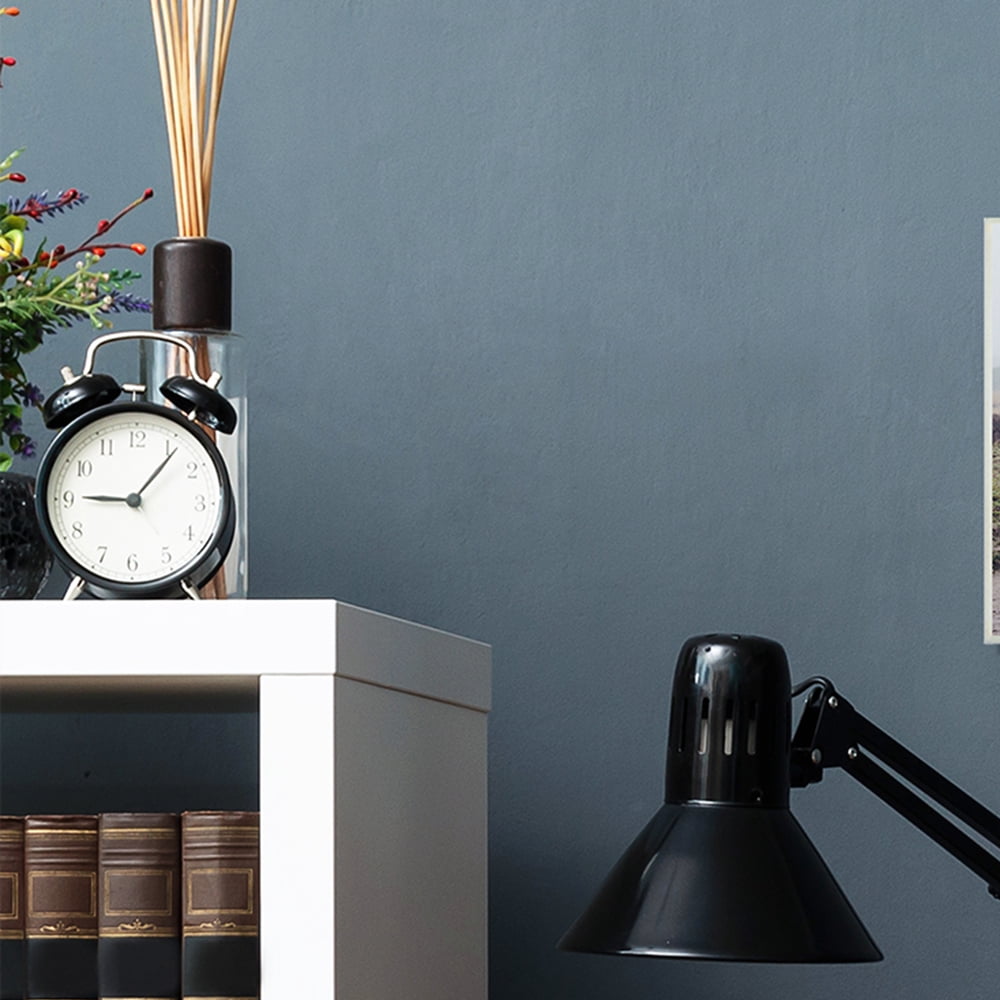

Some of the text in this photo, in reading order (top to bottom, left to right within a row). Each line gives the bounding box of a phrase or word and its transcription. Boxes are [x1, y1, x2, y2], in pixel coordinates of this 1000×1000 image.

[100, 439, 113, 456] 11
[129, 431, 146, 448] 12
[77, 460, 92, 477] 10
[186, 462, 198, 479] 2
[63, 491, 74, 508] 9
[195, 495, 206, 512] 3
[72, 521, 83, 538] 8
[183, 525, 195, 541] 4
[97, 546, 108, 563] 7
[127, 554, 139, 571] 6
[161, 546, 172, 563] 5
